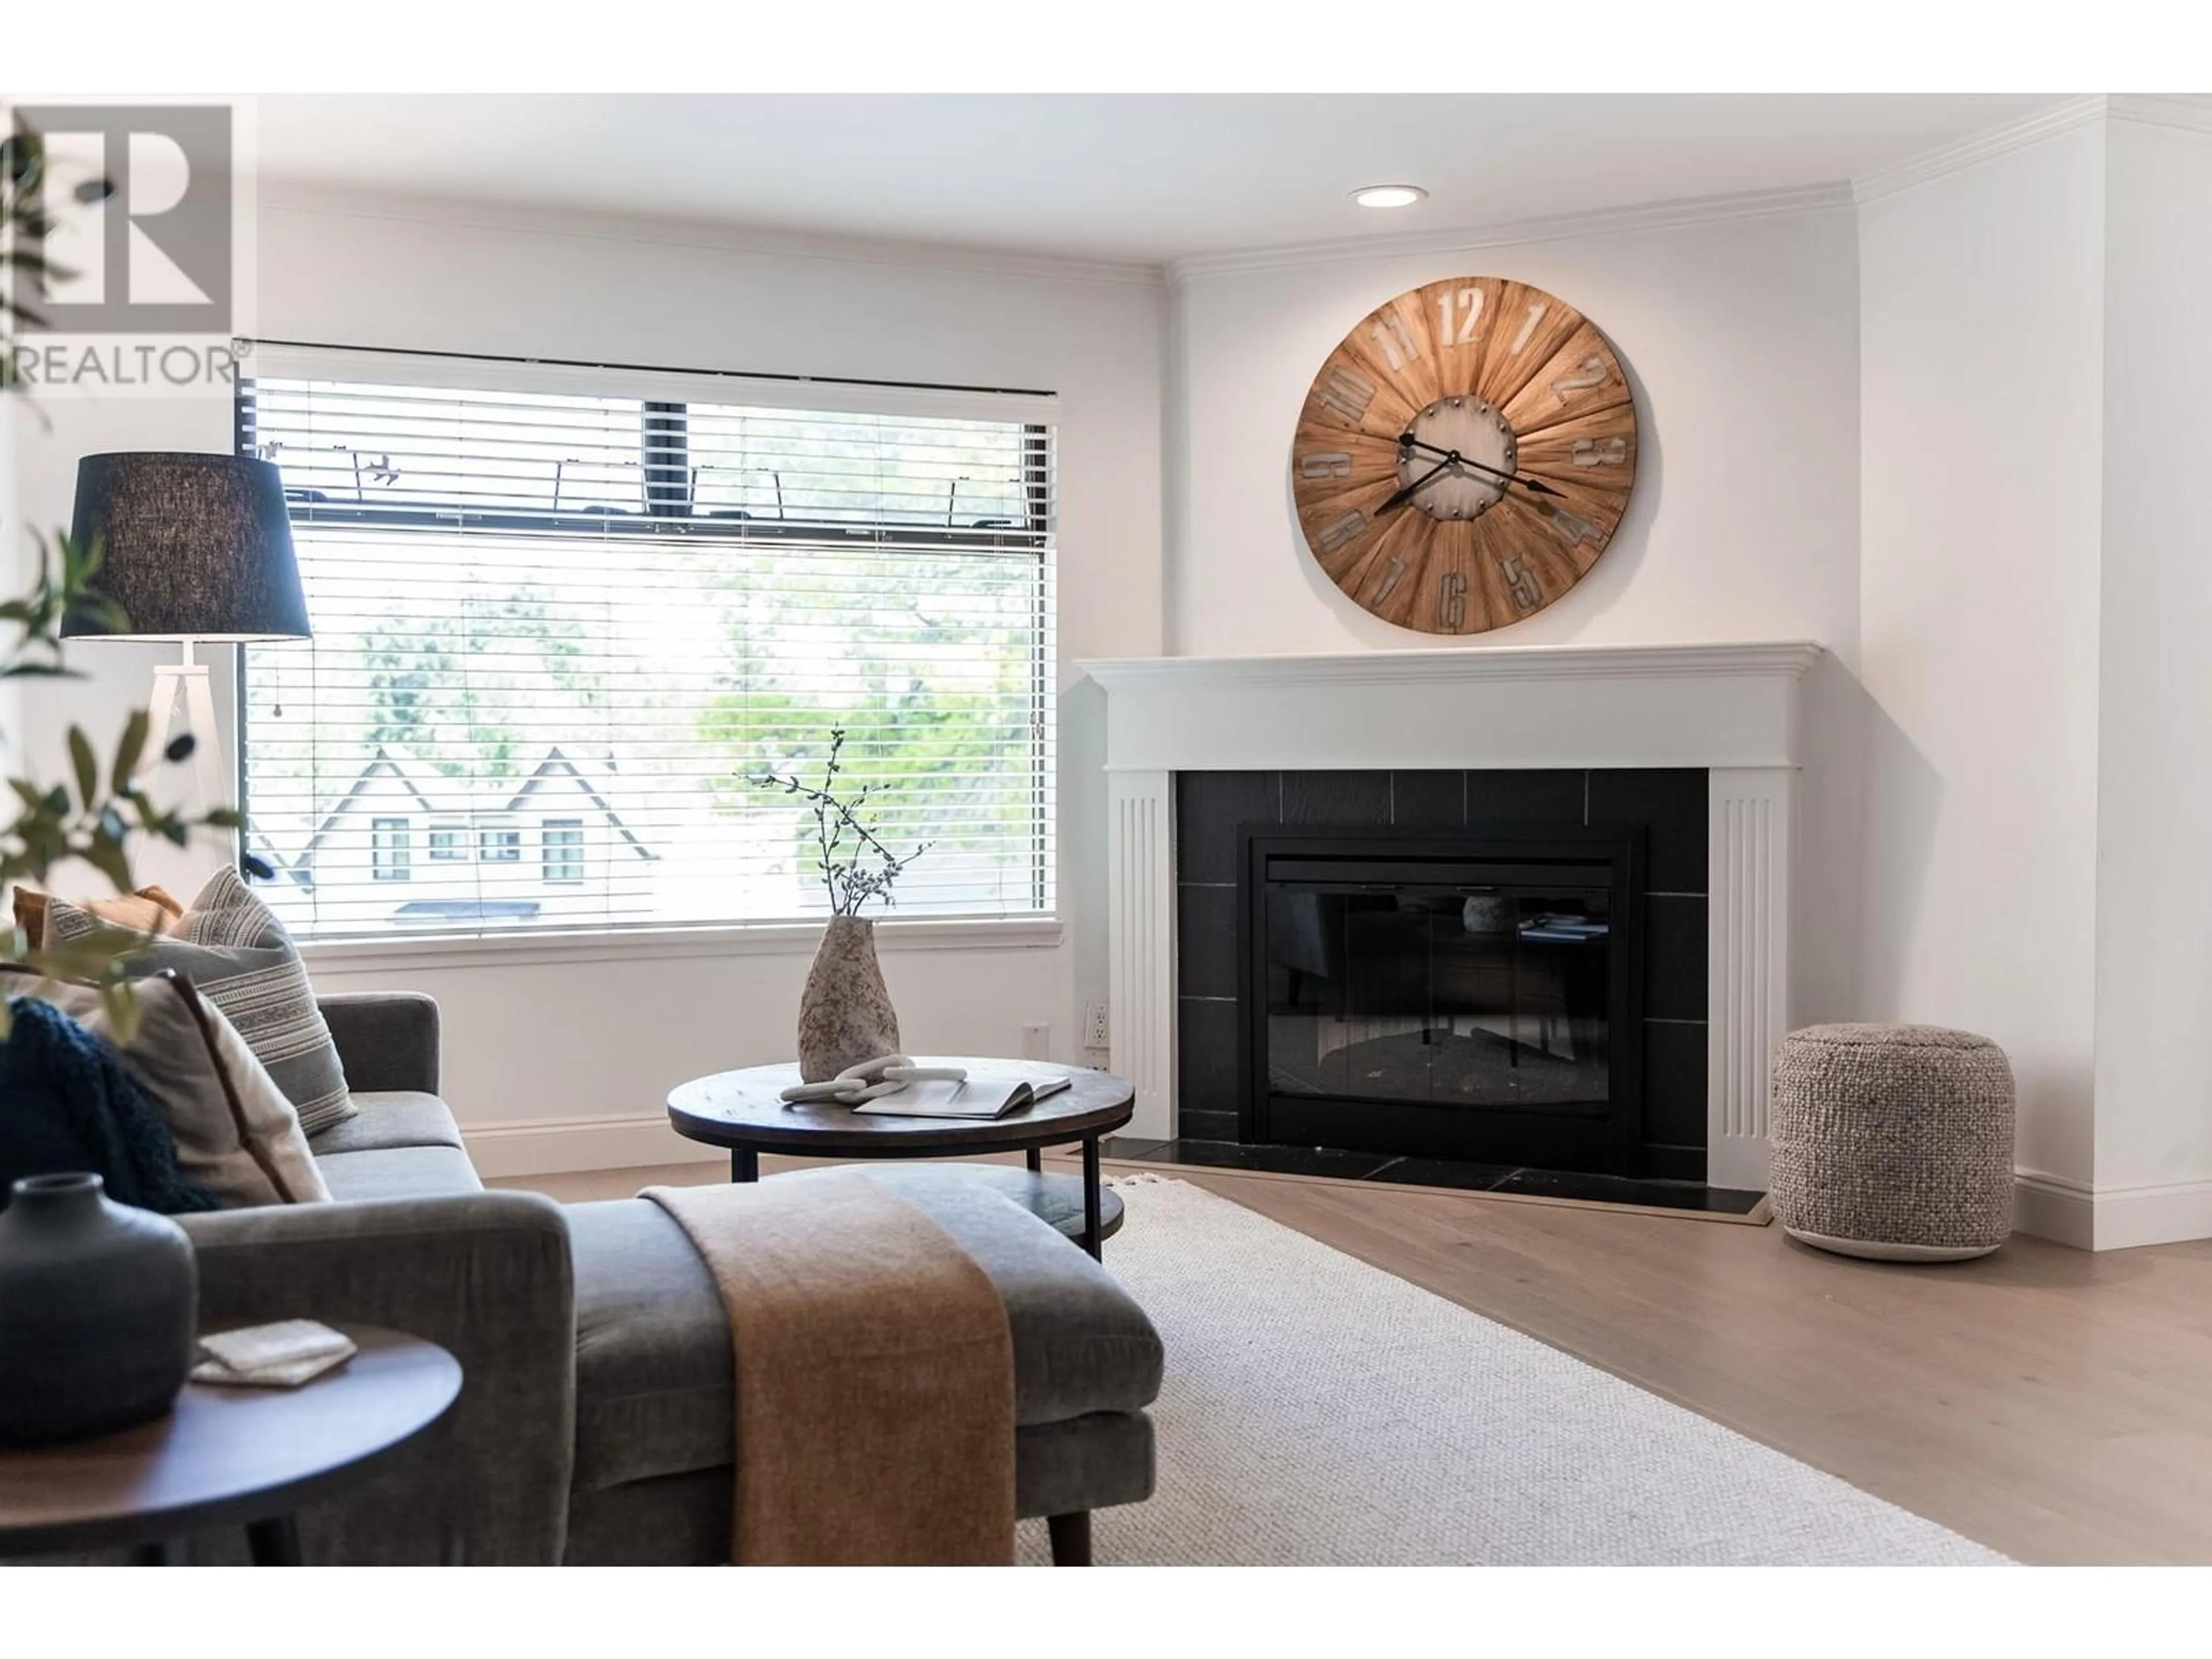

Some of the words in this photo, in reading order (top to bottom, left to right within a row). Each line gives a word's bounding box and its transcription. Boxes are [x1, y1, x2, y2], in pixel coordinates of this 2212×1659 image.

[1372, 313, 1419, 372] 11
[1437, 287, 1484, 346] 12
[1510, 301, 1547, 355] 1
[1551, 353, 1608, 406] 2
[1571, 437, 1627, 466] 3
[1371, 556, 1406, 605] 7
[1440, 572, 1467, 628] 6
[1502, 553, 1544, 609] 5
